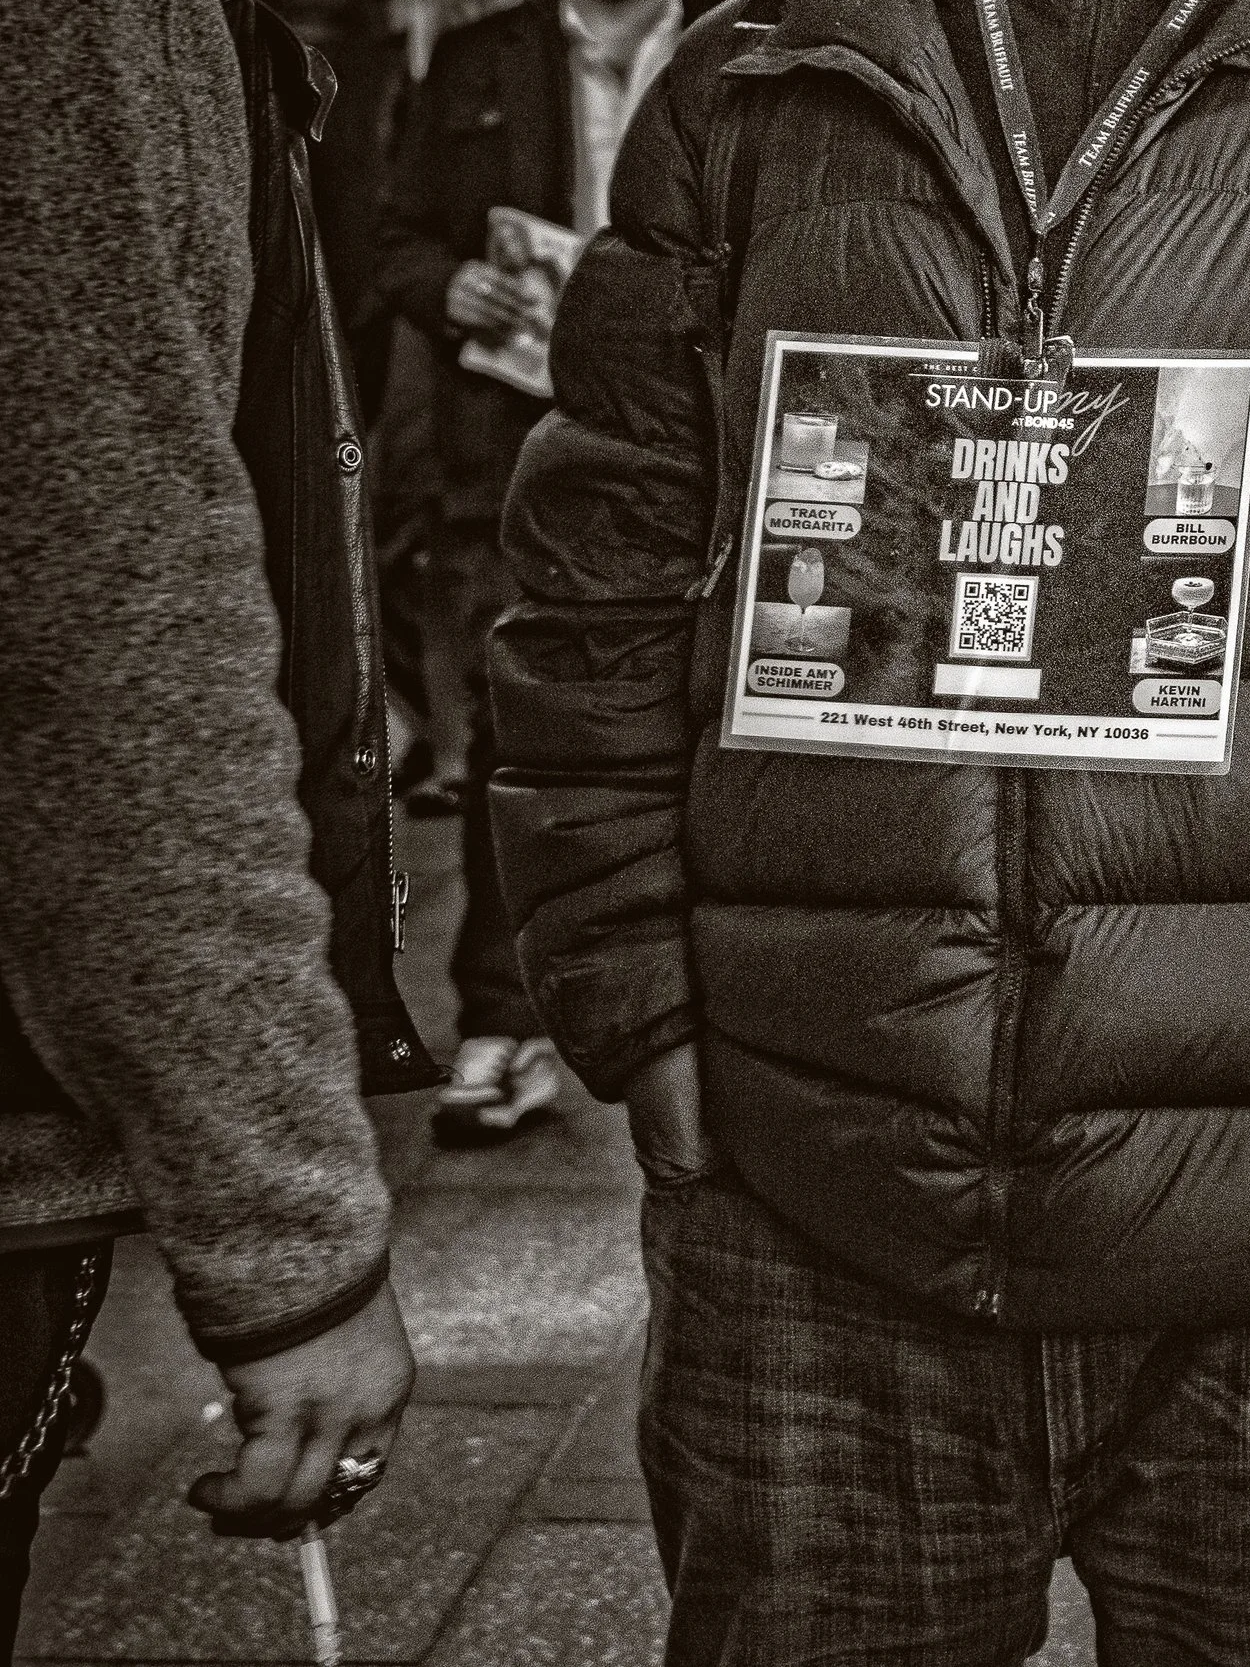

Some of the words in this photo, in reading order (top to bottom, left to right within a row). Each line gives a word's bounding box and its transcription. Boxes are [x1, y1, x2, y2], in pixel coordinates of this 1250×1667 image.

[1079, 129, 1111, 167] TEAM
[1104, 66, 1151, 130] BRIFFAULT
[1012, 131, 1030, 170] TEAM
[925, 383, 1058, 414] STAND-UP
[951, 438, 1070, 484] DRINKS
[972, 480, 1041, 524] AND
[790, 507, 837, 520] TRACY
[769, 518, 855, 533] MORGARITA
[1176, 523, 1205, 534] BILL
[940, 519, 1065, 566] LAUGHS
[1151, 534, 1227, 546] BURRBOUN
[754, 664, 802, 678] INSIDE
[806, 668, 838, 680] AMY
[757, 676, 833, 691] SCHIMMER
[1158, 685, 1201, 696] KEVIN
[1150, 696, 1206, 708] HARTINI
[820, 711, 849, 725] 221
[854, 713, 893, 729] West
[897, 716, 932, 731] 46th
[937, 719, 990, 737] Street,
[994, 722, 1029, 737] New
[1033, 724, 1072, 740] York,
[1076, 726, 1100, 739] NY
[1103, 727, 1150, 741] 10036
